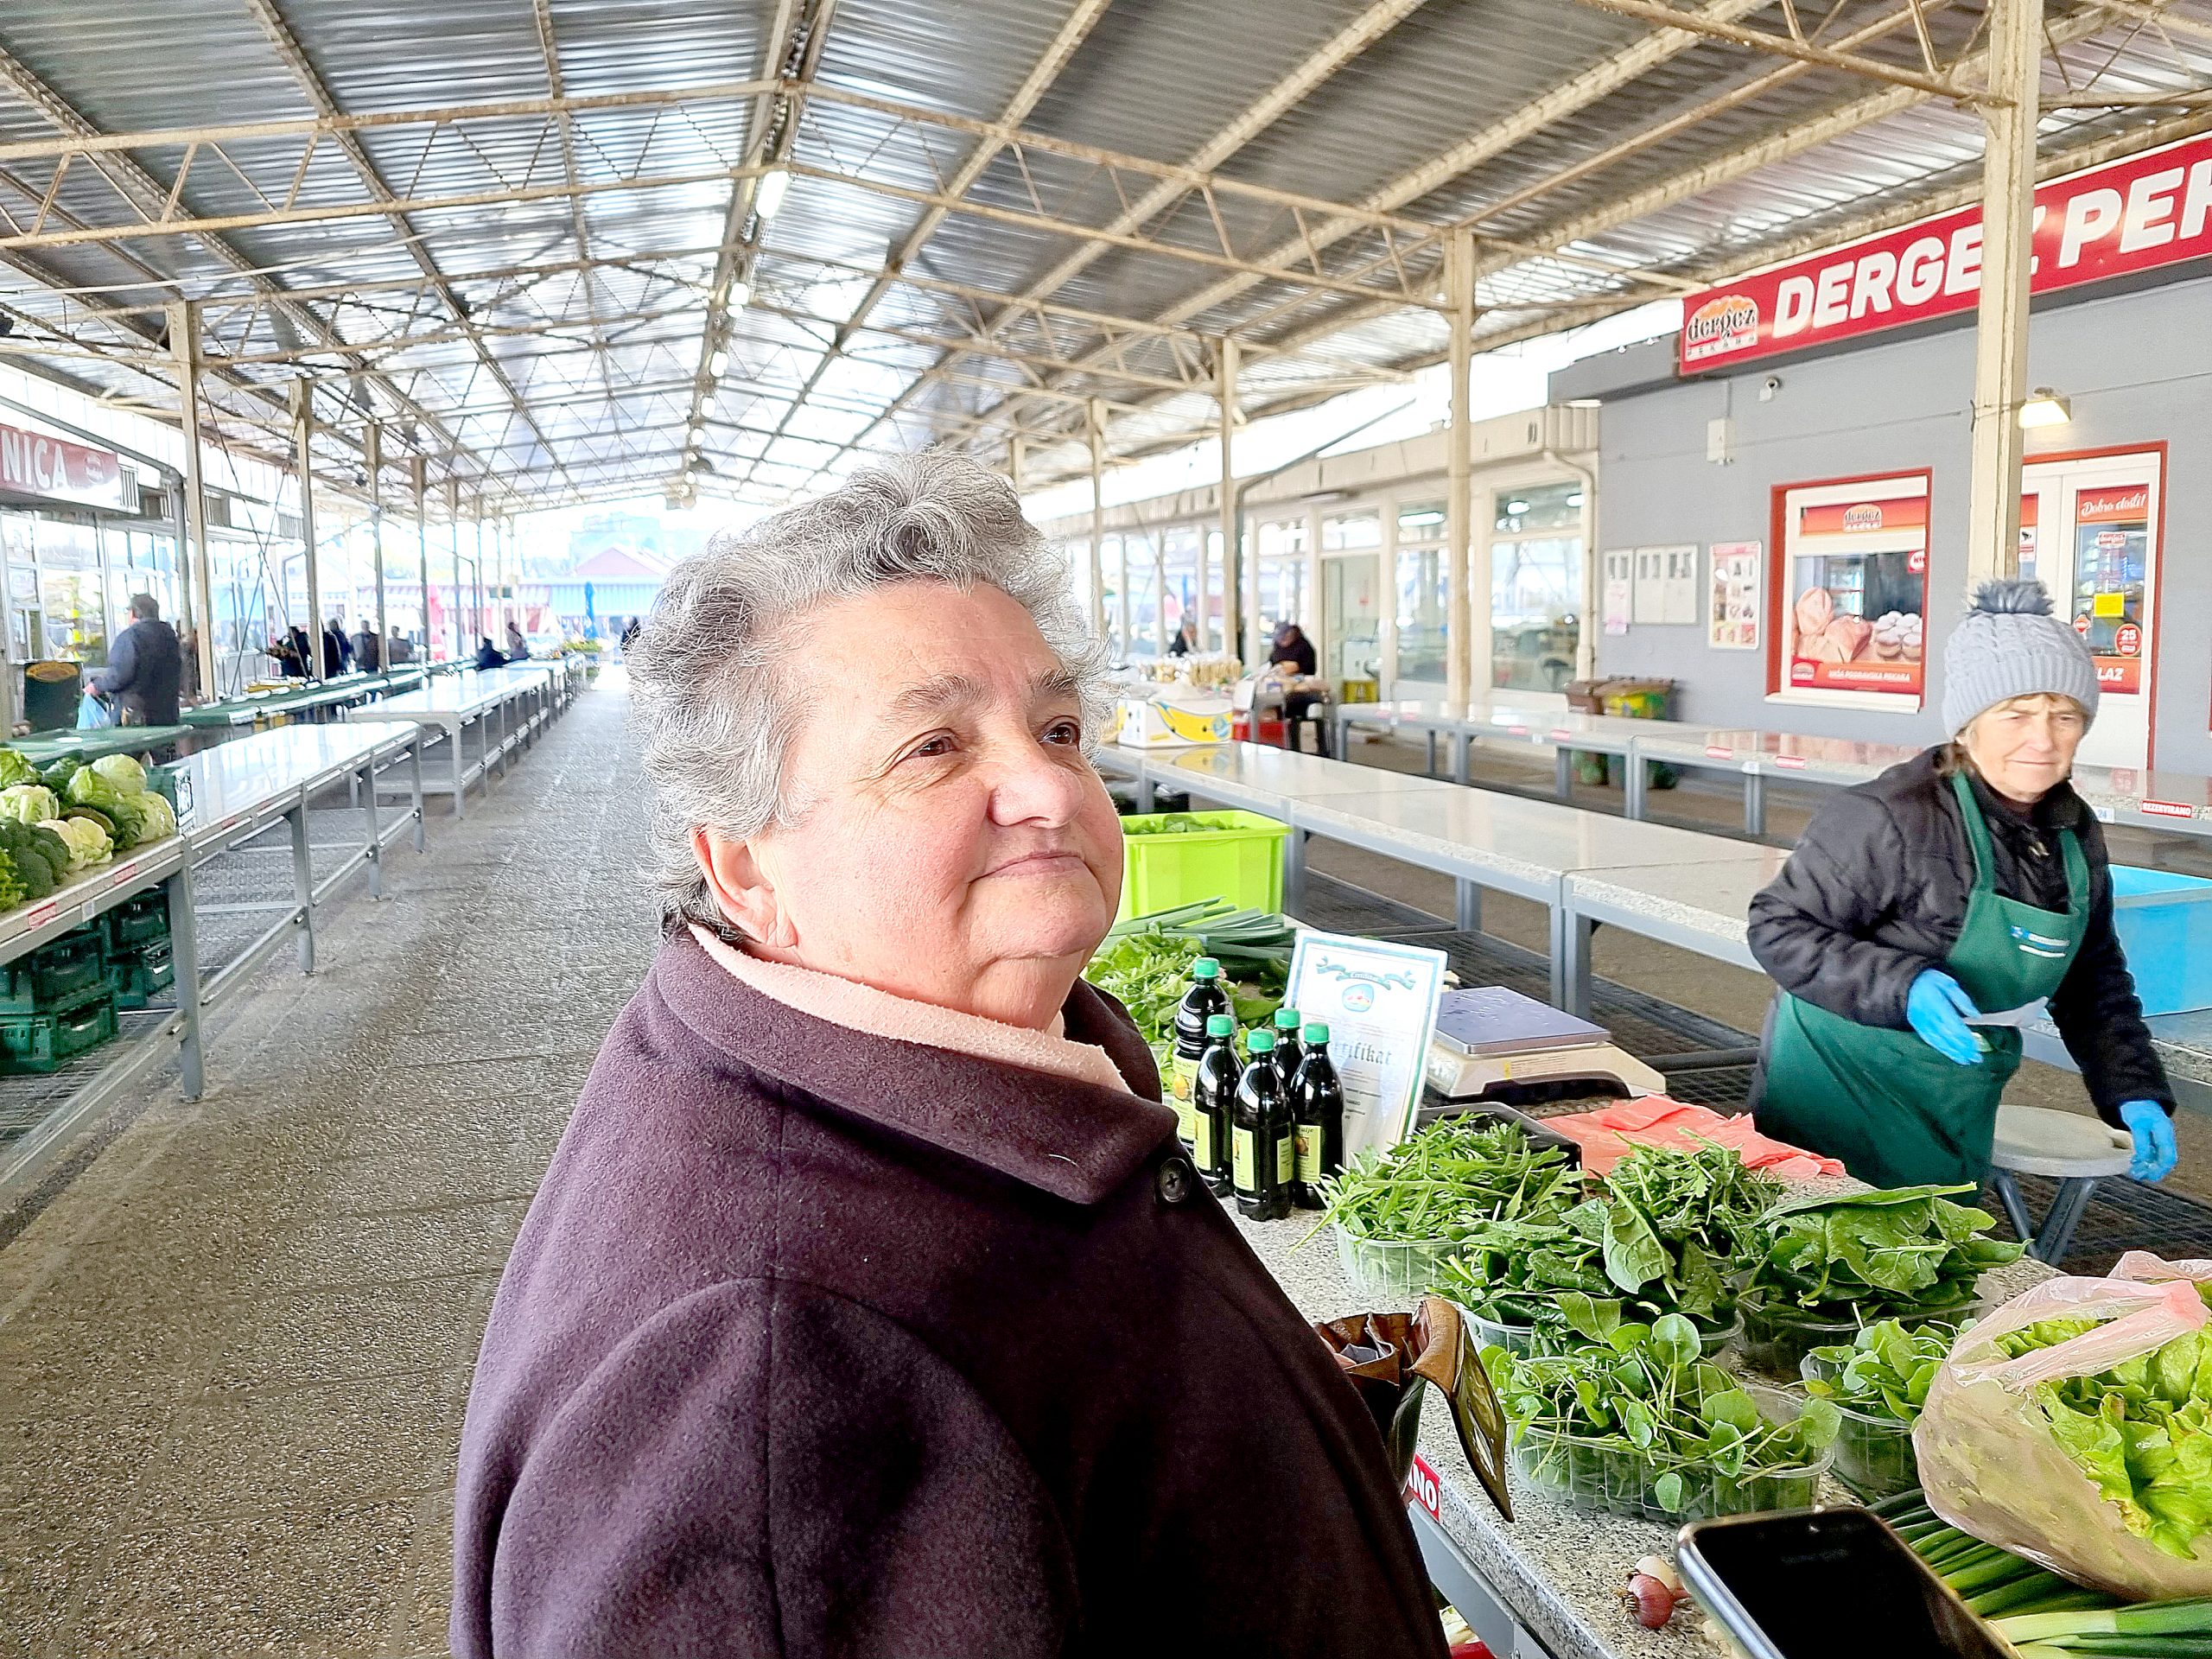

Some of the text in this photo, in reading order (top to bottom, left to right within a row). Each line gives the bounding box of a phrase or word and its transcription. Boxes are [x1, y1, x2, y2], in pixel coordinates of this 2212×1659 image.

[1772, 206, 2046, 339] DERGE
[1688, 308, 1755, 342] dergez
[0, 429, 70, 491] NICA
[2081, 498, 2114, 518] Dobro
[2120, 629, 2137, 641] 25
[2142, 802, 2191, 817] REZERVIRANO
